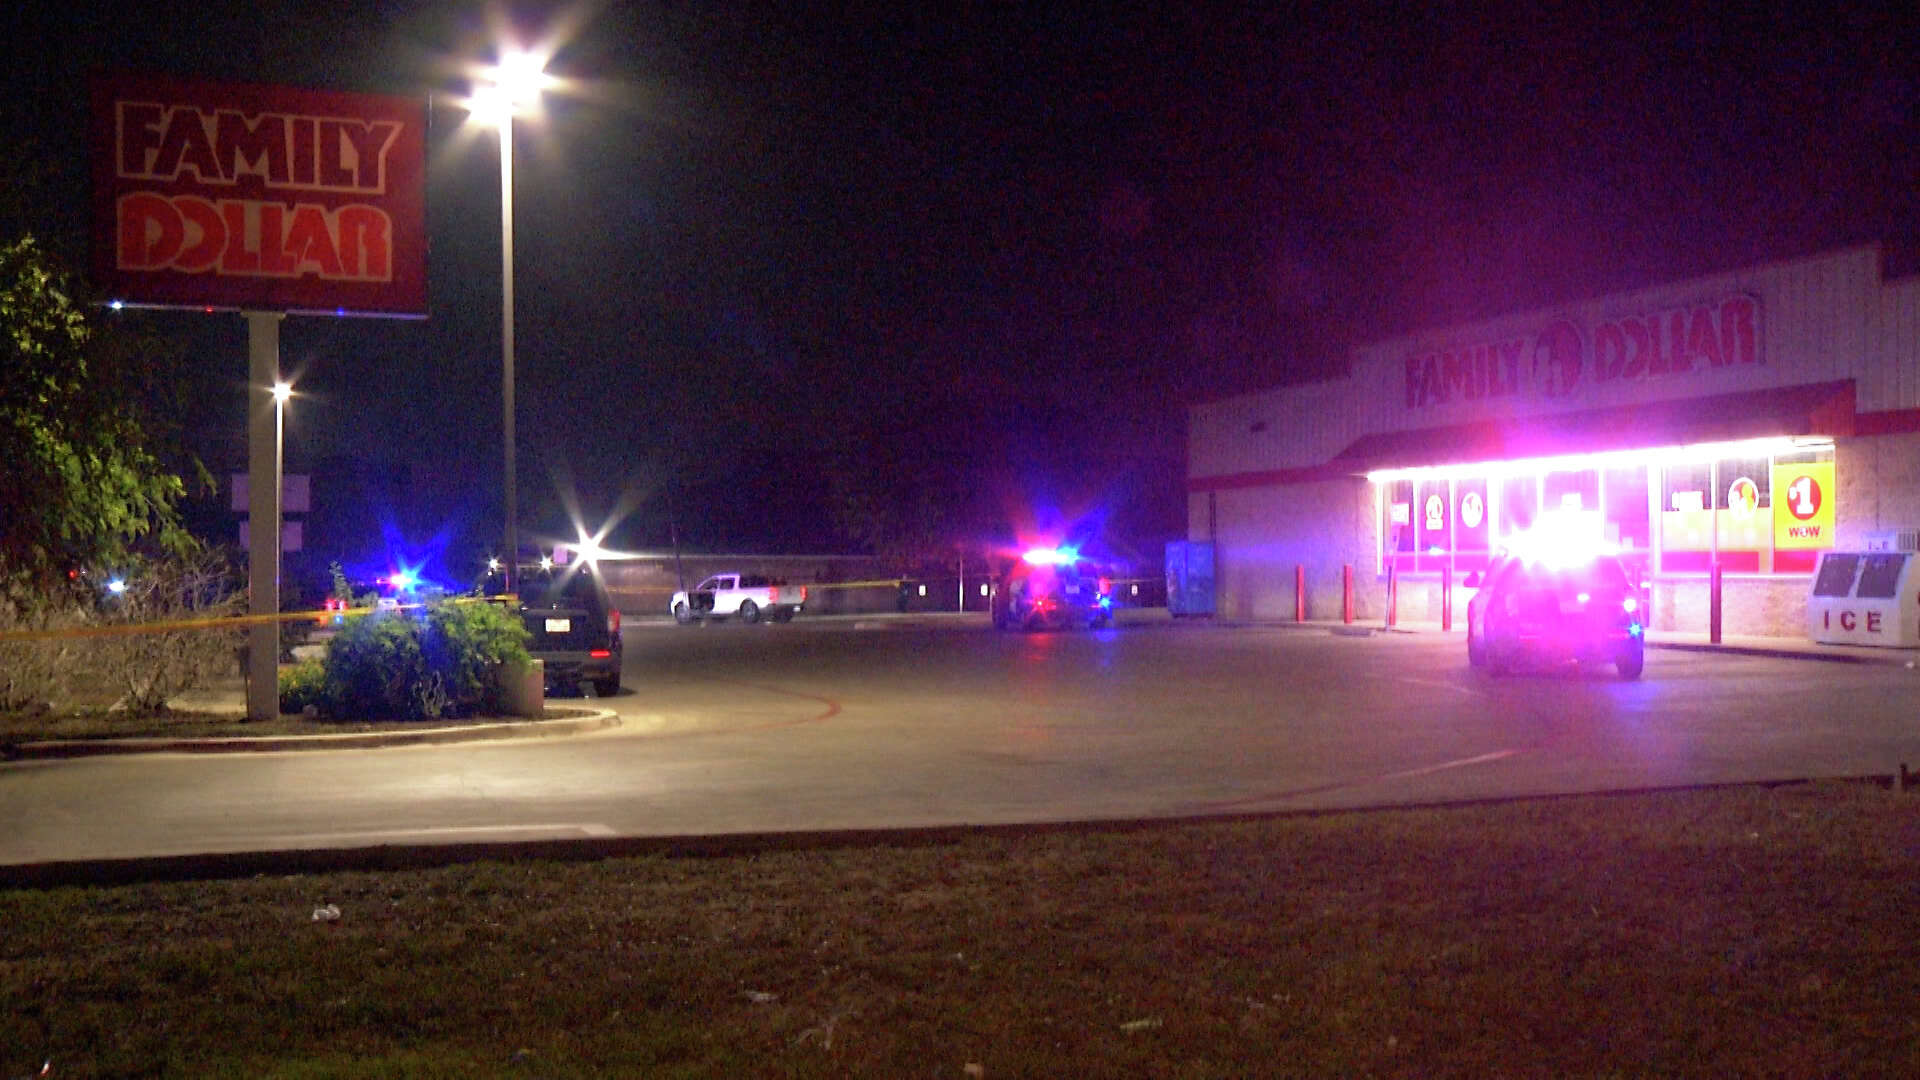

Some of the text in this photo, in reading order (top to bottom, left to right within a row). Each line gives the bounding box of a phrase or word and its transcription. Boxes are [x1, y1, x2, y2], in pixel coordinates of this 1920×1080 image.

[117, 102, 403, 193] FAMILY
[117, 192, 392, 281] DOLLAR
[1404, 298, 1757, 409] FAMILY DOLLAR
[1788, 526, 1820, 537] WOW
[1824, 609, 1882, 632] ICE
